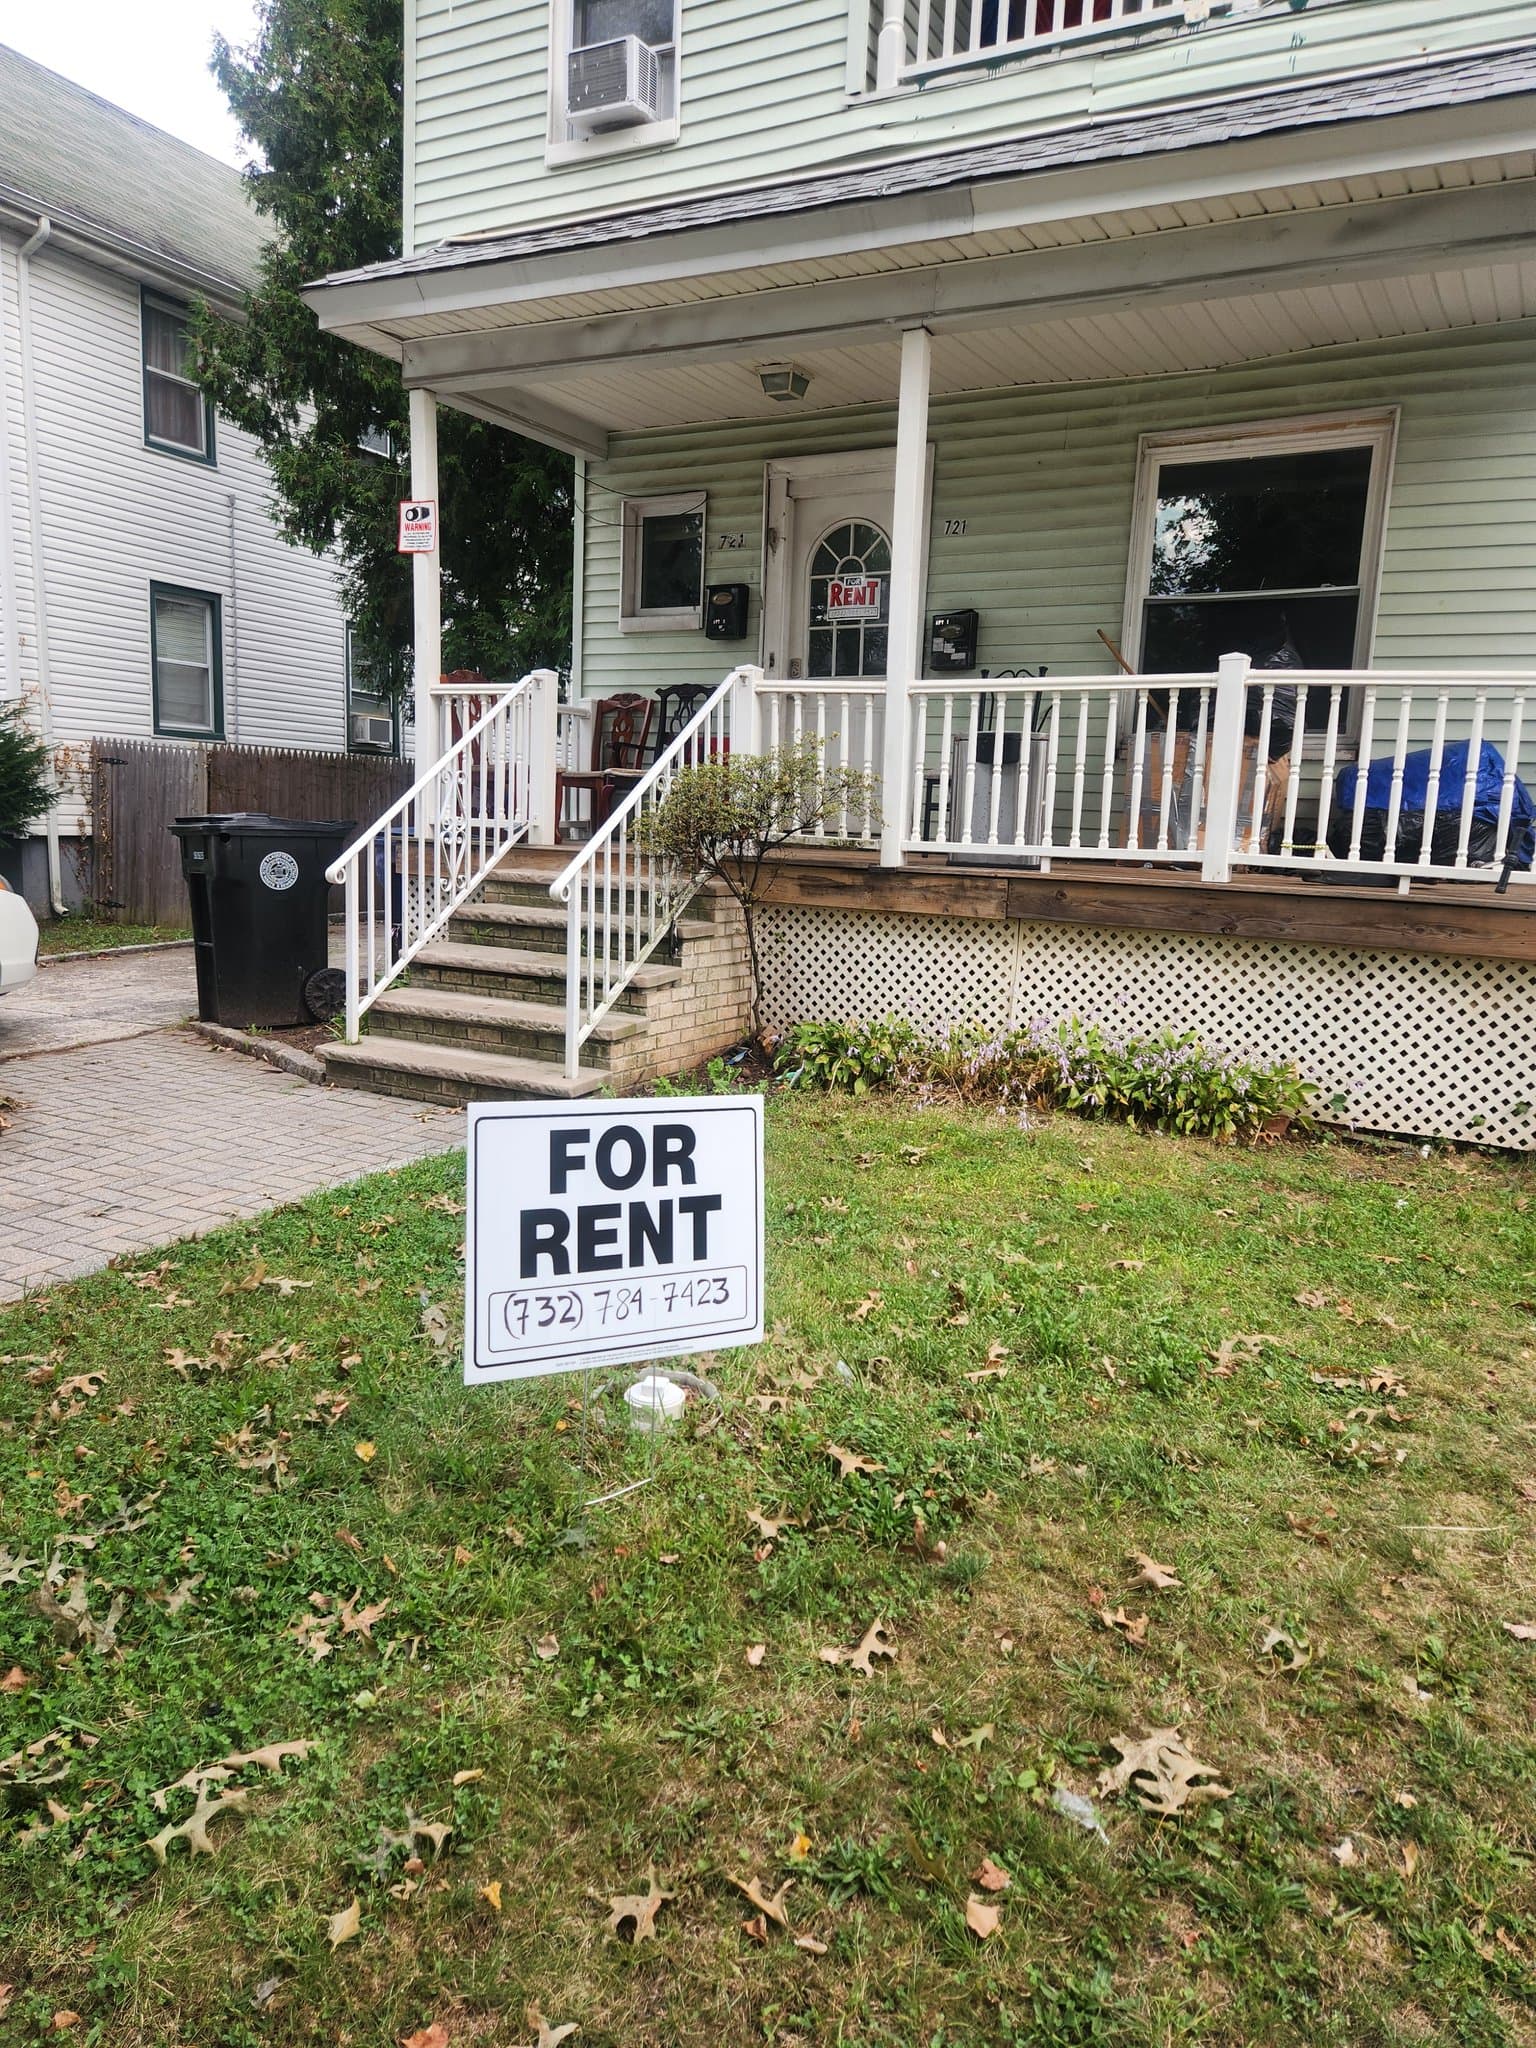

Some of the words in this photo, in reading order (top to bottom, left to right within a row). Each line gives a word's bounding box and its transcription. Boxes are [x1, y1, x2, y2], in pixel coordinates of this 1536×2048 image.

[405, 522, 432, 531] WARNING
[945, 520, 967, 536] 721
[719, 533, 745, 550] 721
[830, 581, 878, 608] RENT
[550, 1124, 696, 1194] FOR
[520, 1195, 722, 1279] RENT
[504, 1290, 583, 1339] (732)
